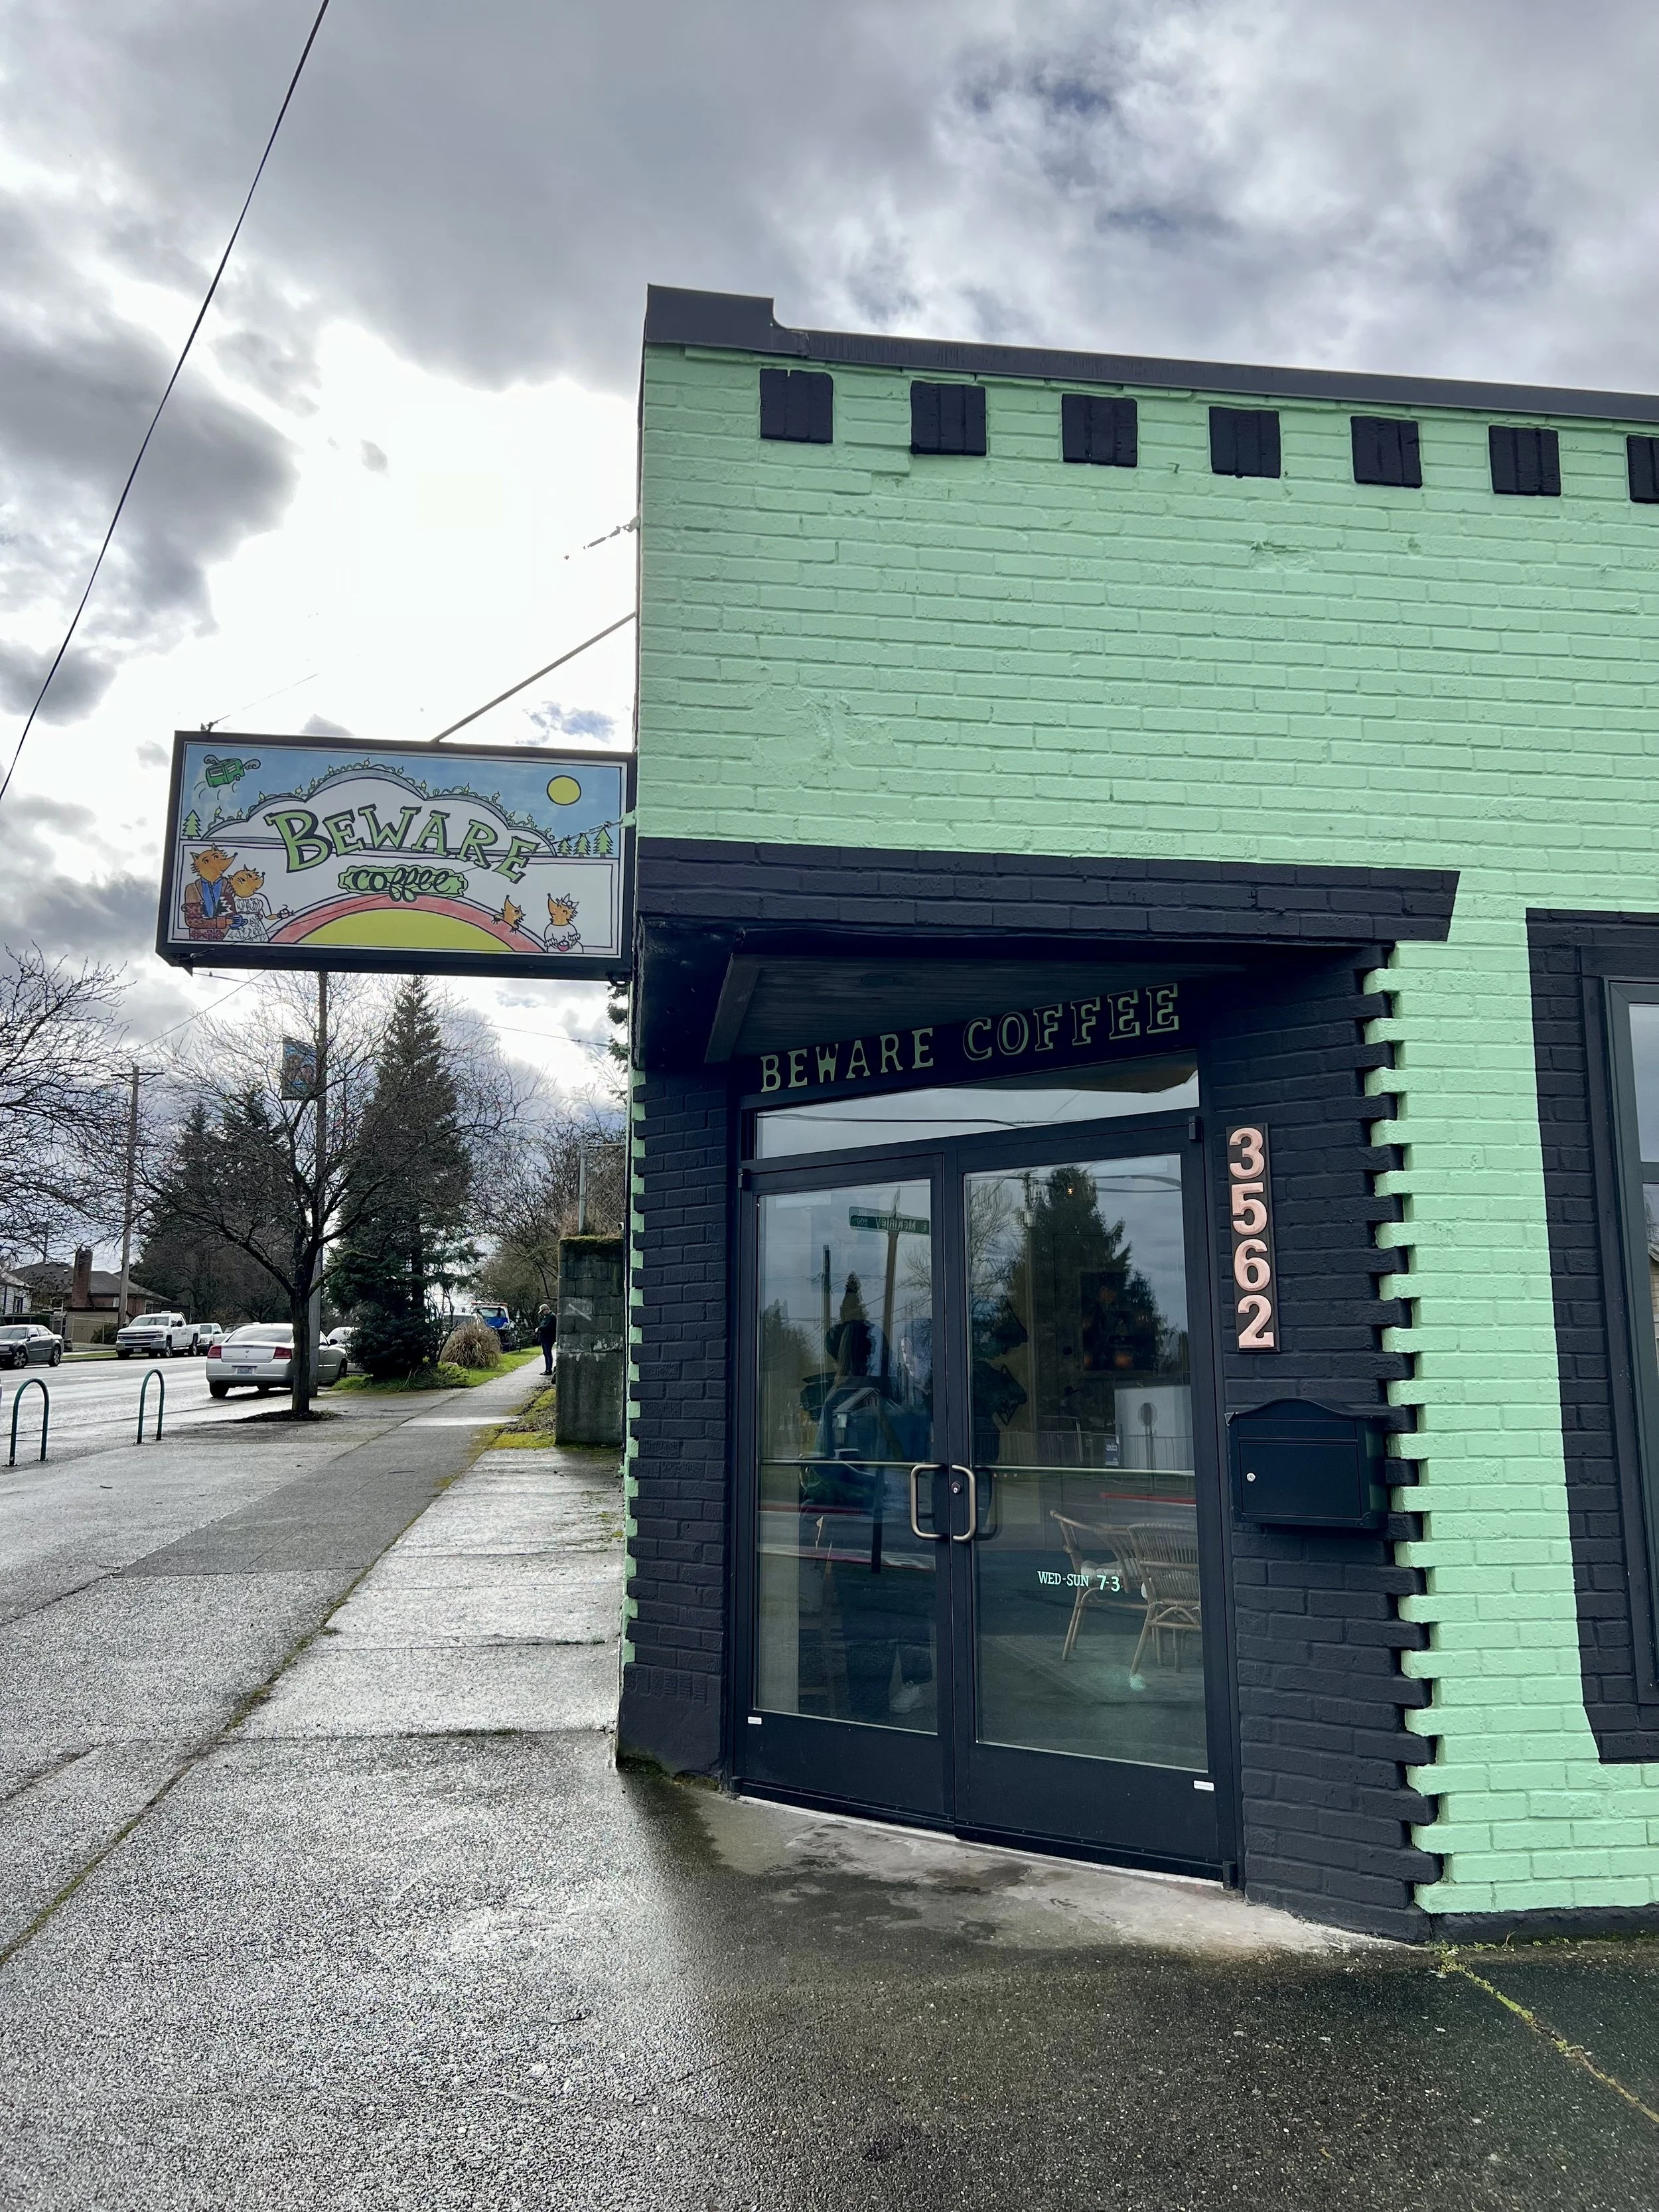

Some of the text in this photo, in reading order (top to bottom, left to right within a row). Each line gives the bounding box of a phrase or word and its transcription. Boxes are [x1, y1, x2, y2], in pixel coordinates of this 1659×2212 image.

[263, 804, 543, 884] BEWARE
[760, 984, 1179, 1092] BEWARE COFFEE
[1229, 1128, 1274, 1349] 3562
[1097, 1575, 1120, 1592] 7-3
